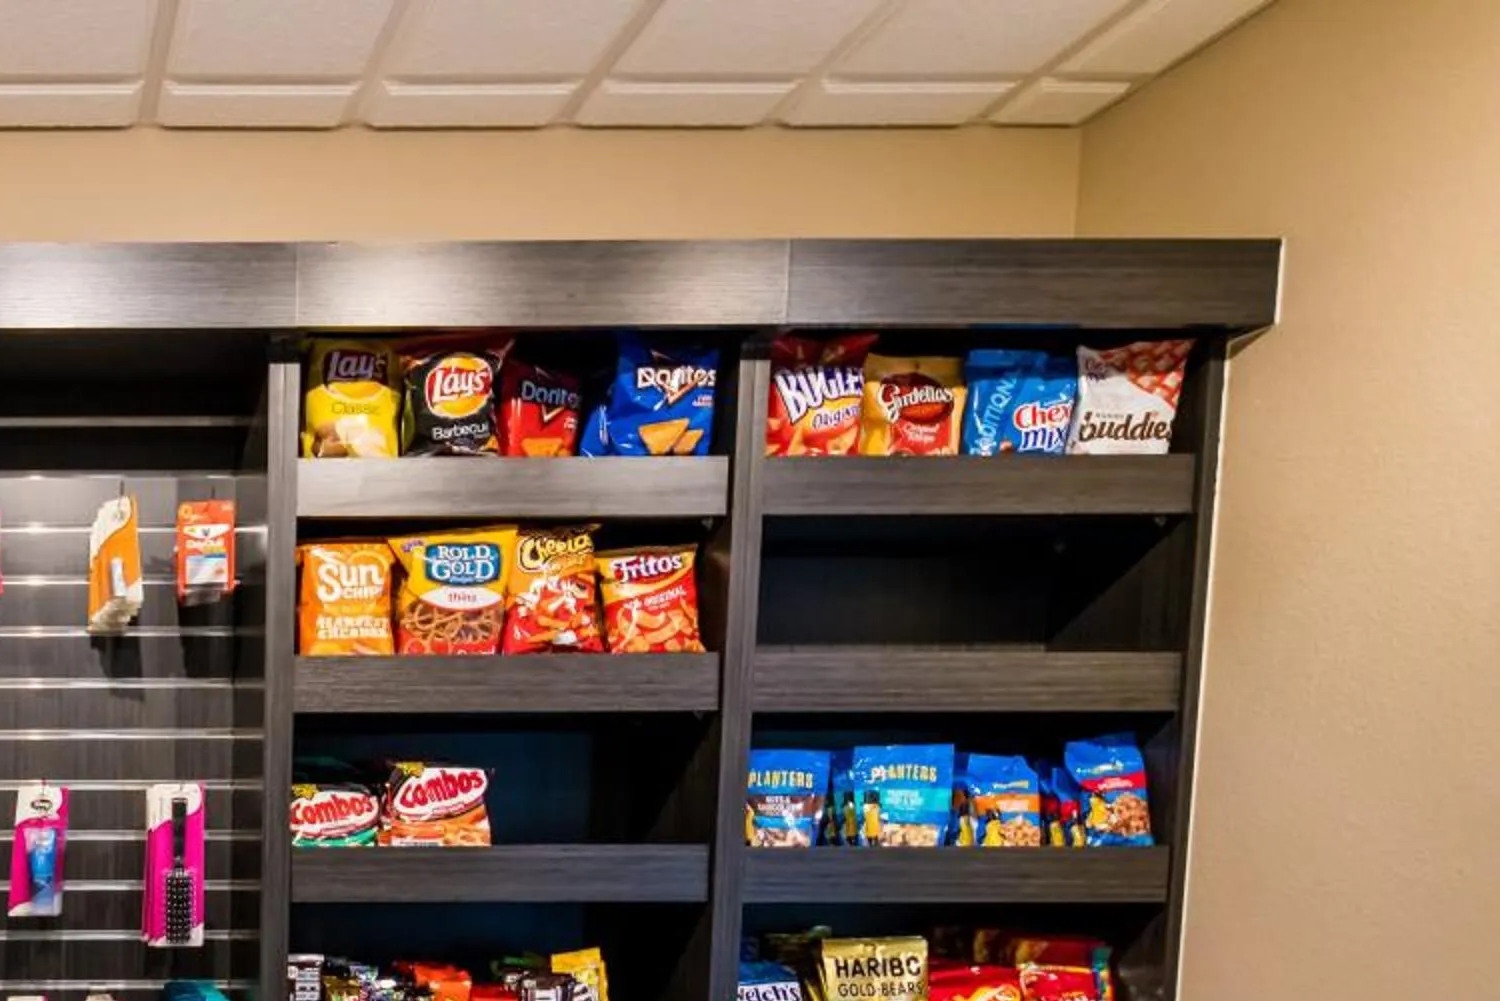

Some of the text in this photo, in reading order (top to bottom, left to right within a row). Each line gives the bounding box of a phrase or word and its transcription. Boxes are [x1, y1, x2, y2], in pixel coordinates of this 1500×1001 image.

[432, 367, 487, 402] Lay's
[636, 365, 717, 389] Doritos
[1013, 400, 1073, 431] Chex
[437, 545, 491, 560] ROLD
[317, 560, 385, 602] Sun
[431, 559, 495, 580] GOLD
[610, 554, 682, 583] Fritos
[399, 769, 484, 808] Combos
[748, 770, 814, 789] PLANTERS
[291, 795, 374, 825] Combos
